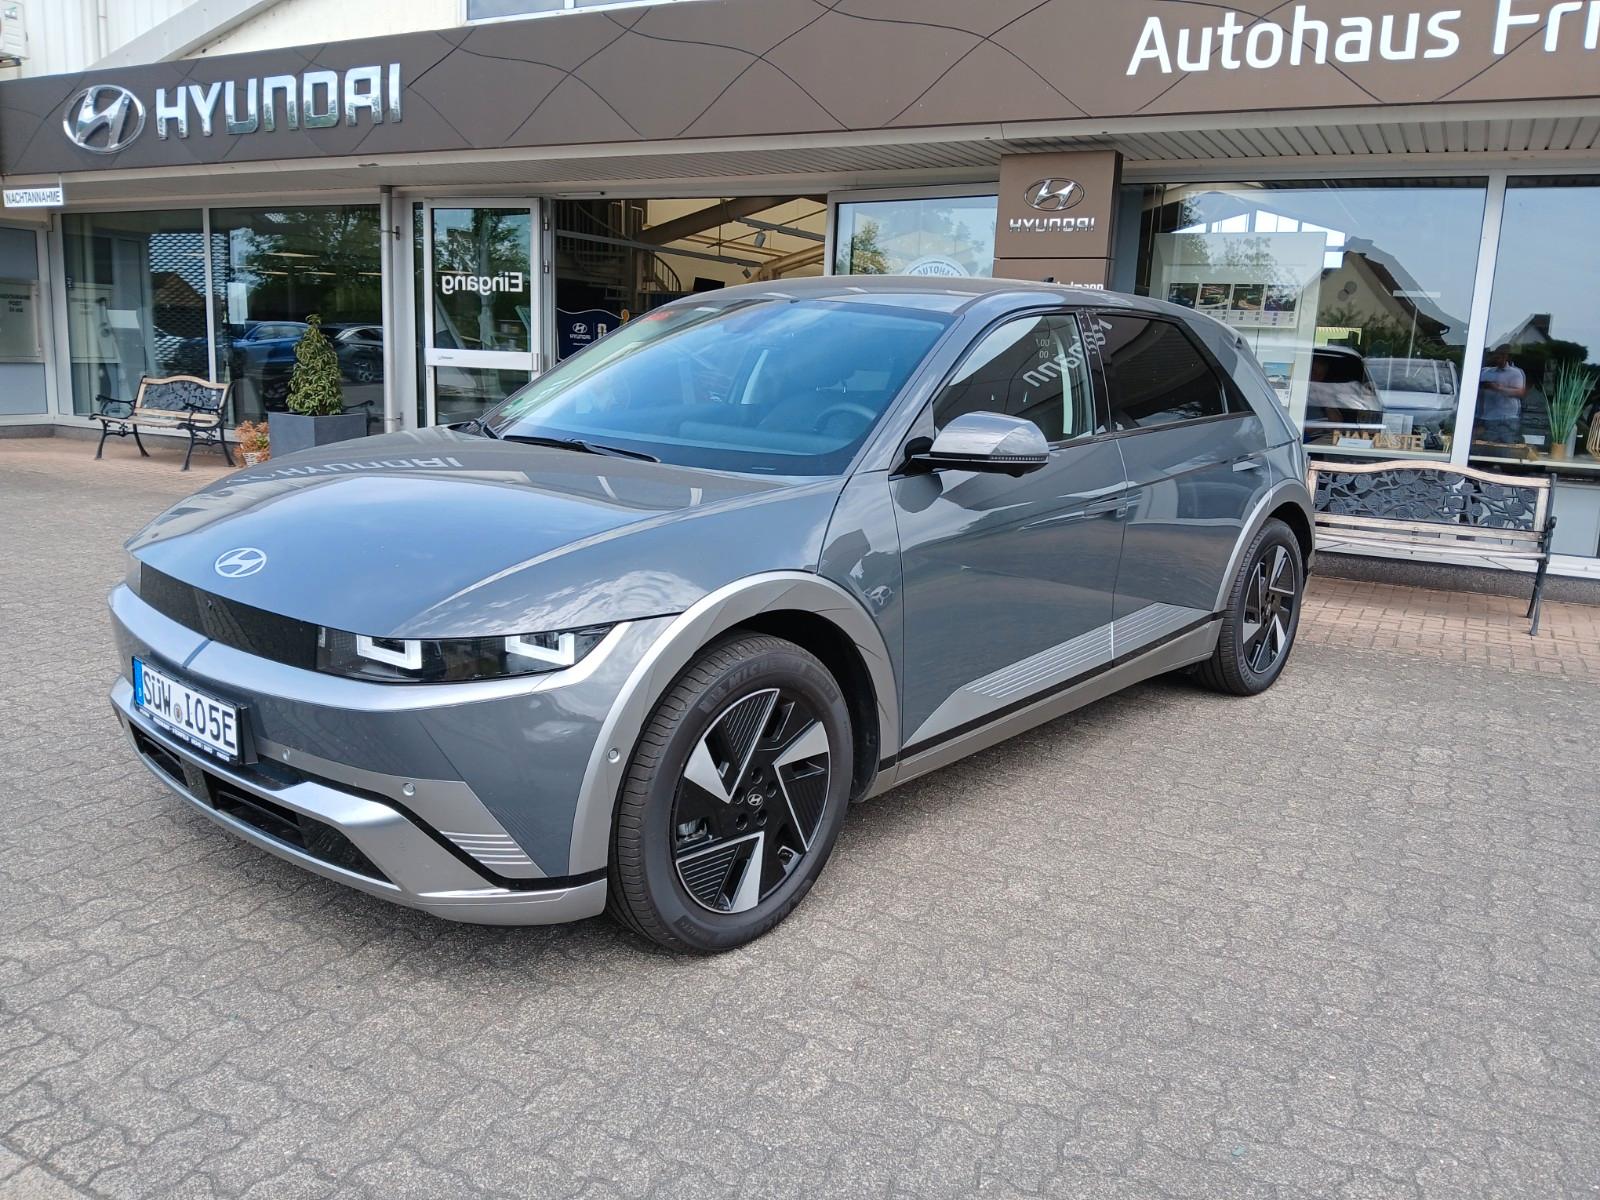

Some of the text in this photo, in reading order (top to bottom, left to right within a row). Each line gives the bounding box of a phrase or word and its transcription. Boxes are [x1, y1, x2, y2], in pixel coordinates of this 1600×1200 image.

[1126, 5, 1461, 75] Autohaus
[155, 63, 402, 140] HYUNDAI
[5, 190, 61, 204] NACHTANNAHME
[1009, 217, 1095, 232] HYUNDAI
[143, 670, 171, 717] SÜW
